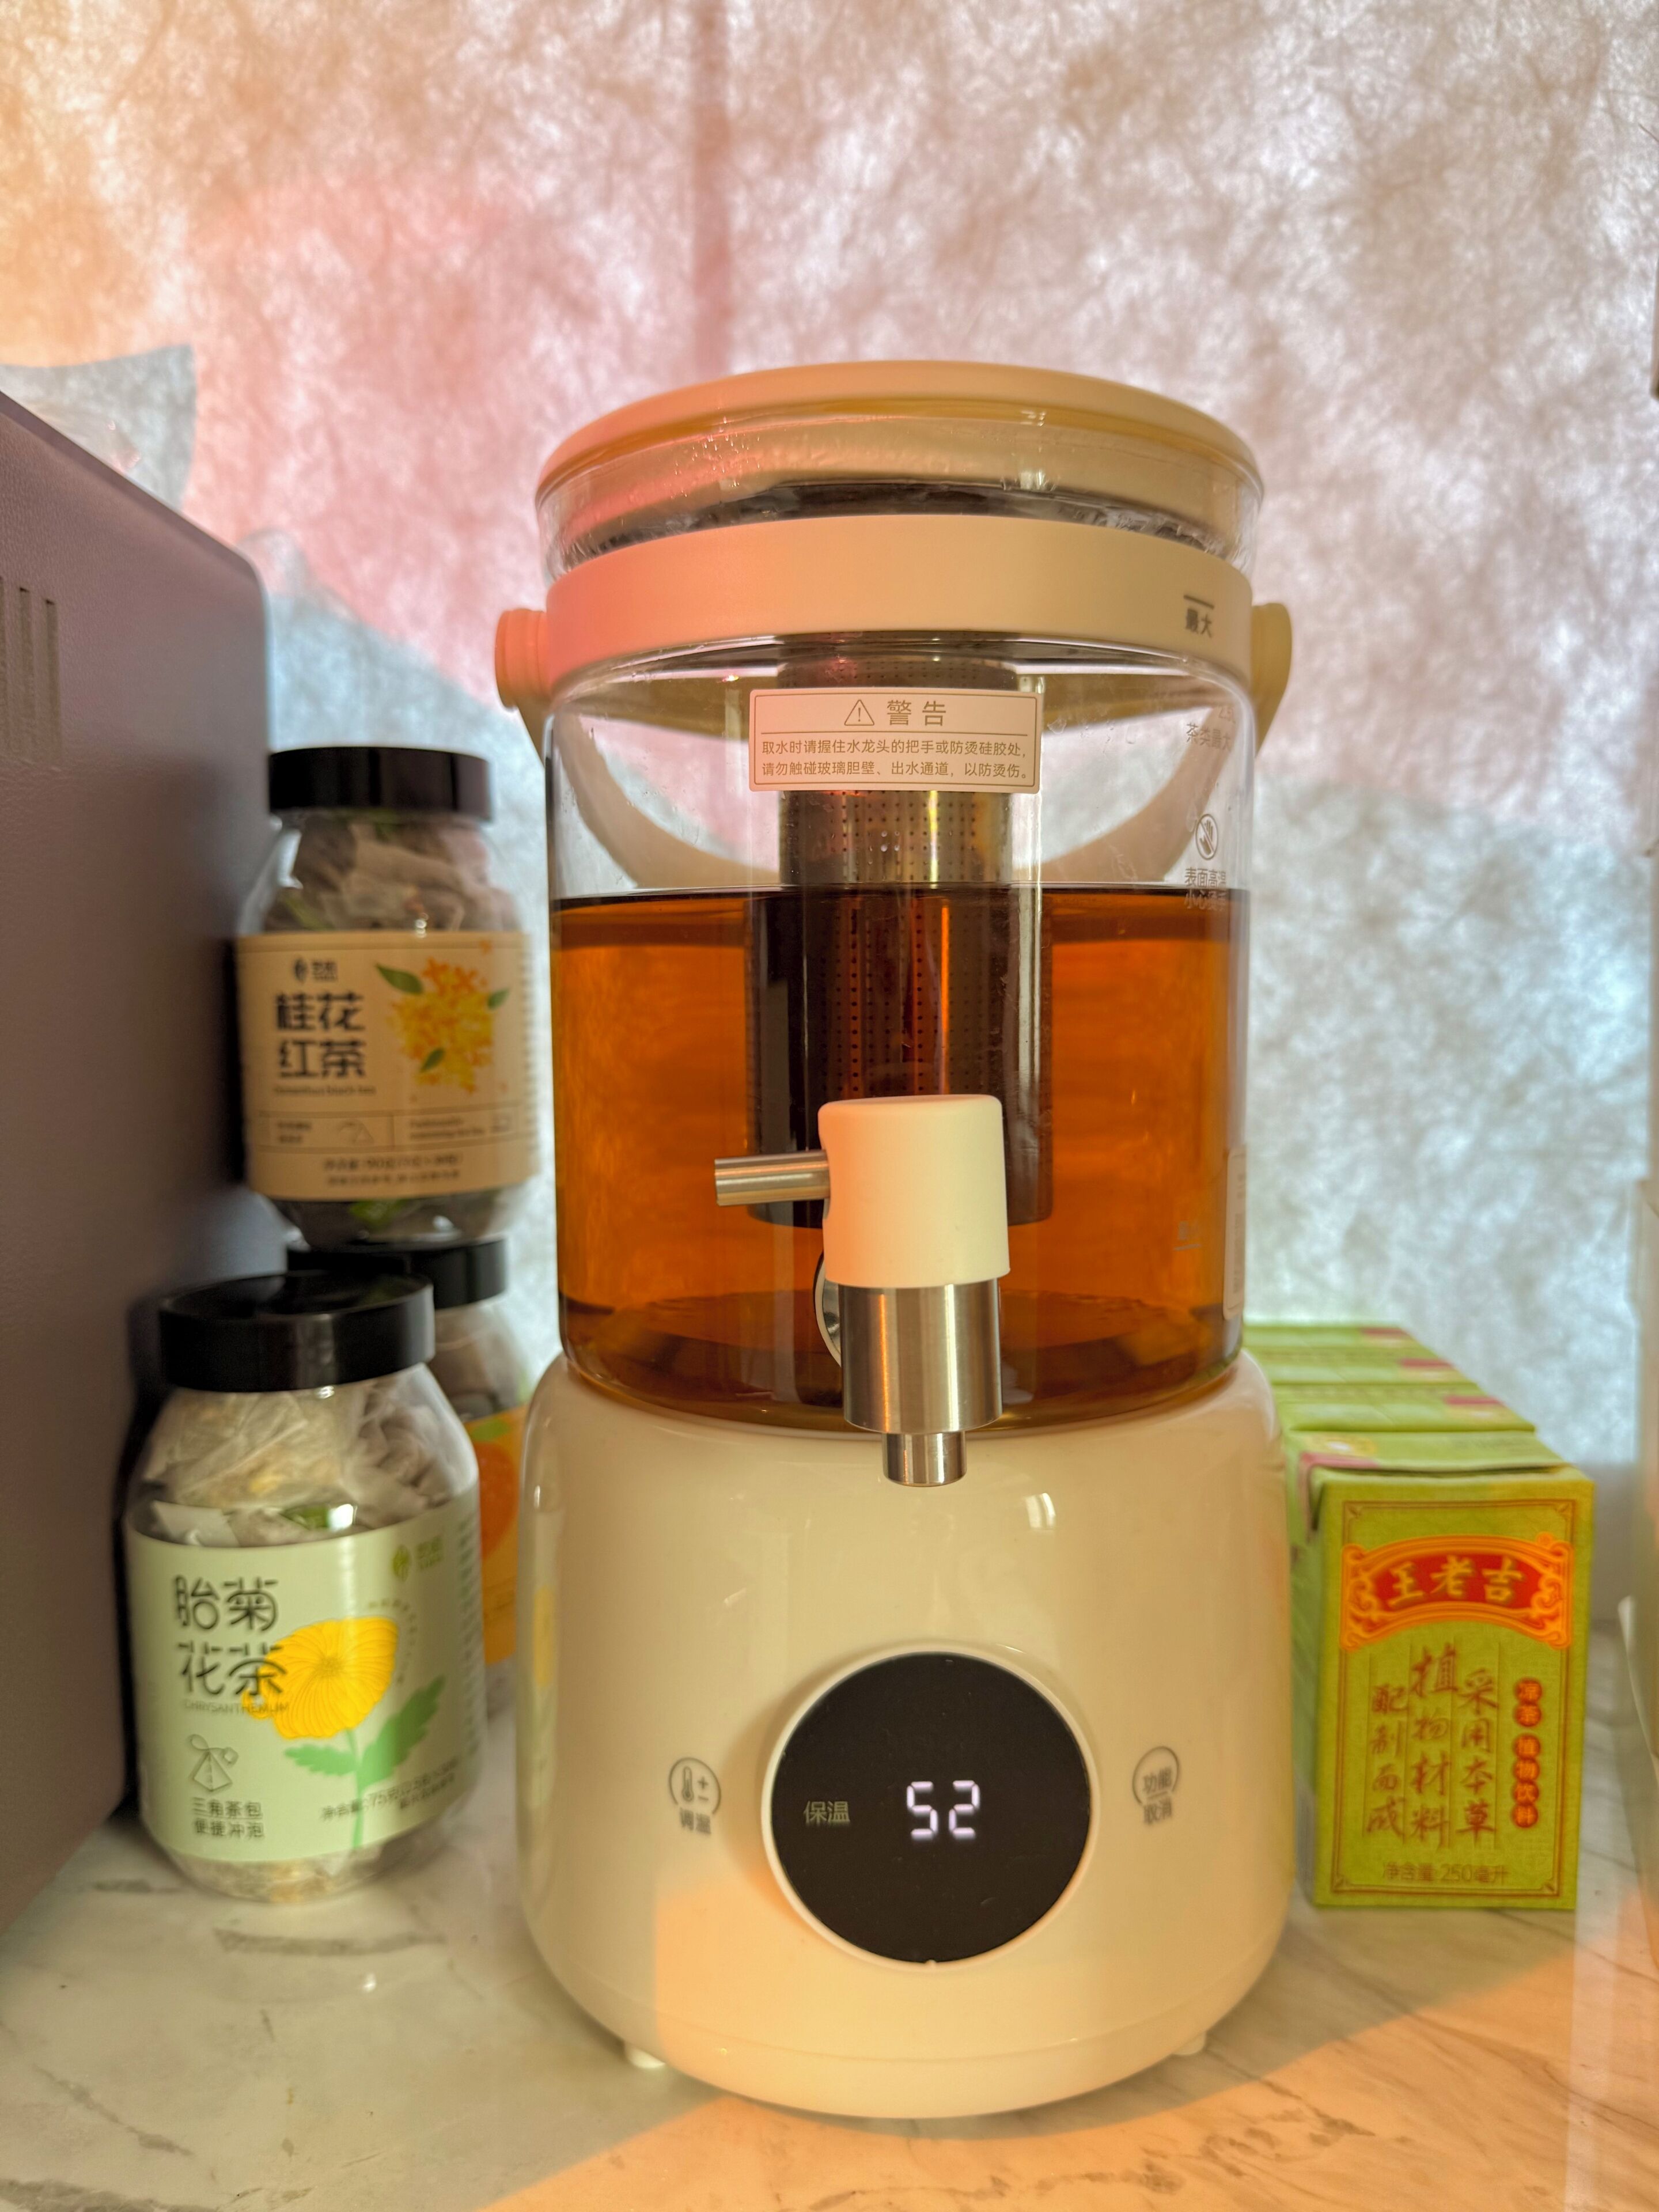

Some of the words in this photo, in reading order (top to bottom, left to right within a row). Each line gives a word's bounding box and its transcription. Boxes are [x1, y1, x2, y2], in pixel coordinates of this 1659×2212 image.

[1186, 608, 1212, 638] 最大
[887, 700, 946, 726] 警告
[276, 992, 366, 1031] 桂花
[279, 1039, 367, 1077] 红茶
[1387, 1555, 1525, 1607] 王老吉
[174, 1575, 279, 1631] 胎菊
[177, 1640, 287, 1697] 花茶
[1410, 1643, 1459, 1849] 植物材料
[1456, 1668, 1498, 1846] 采用本草
[192, 1797, 263, 1816] 三角茶包
[804, 1801, 851, 1824] 保温
[907, 1780, 980, 1839] 52
[194, 1818, 264, 1839] 便捷冲泡
